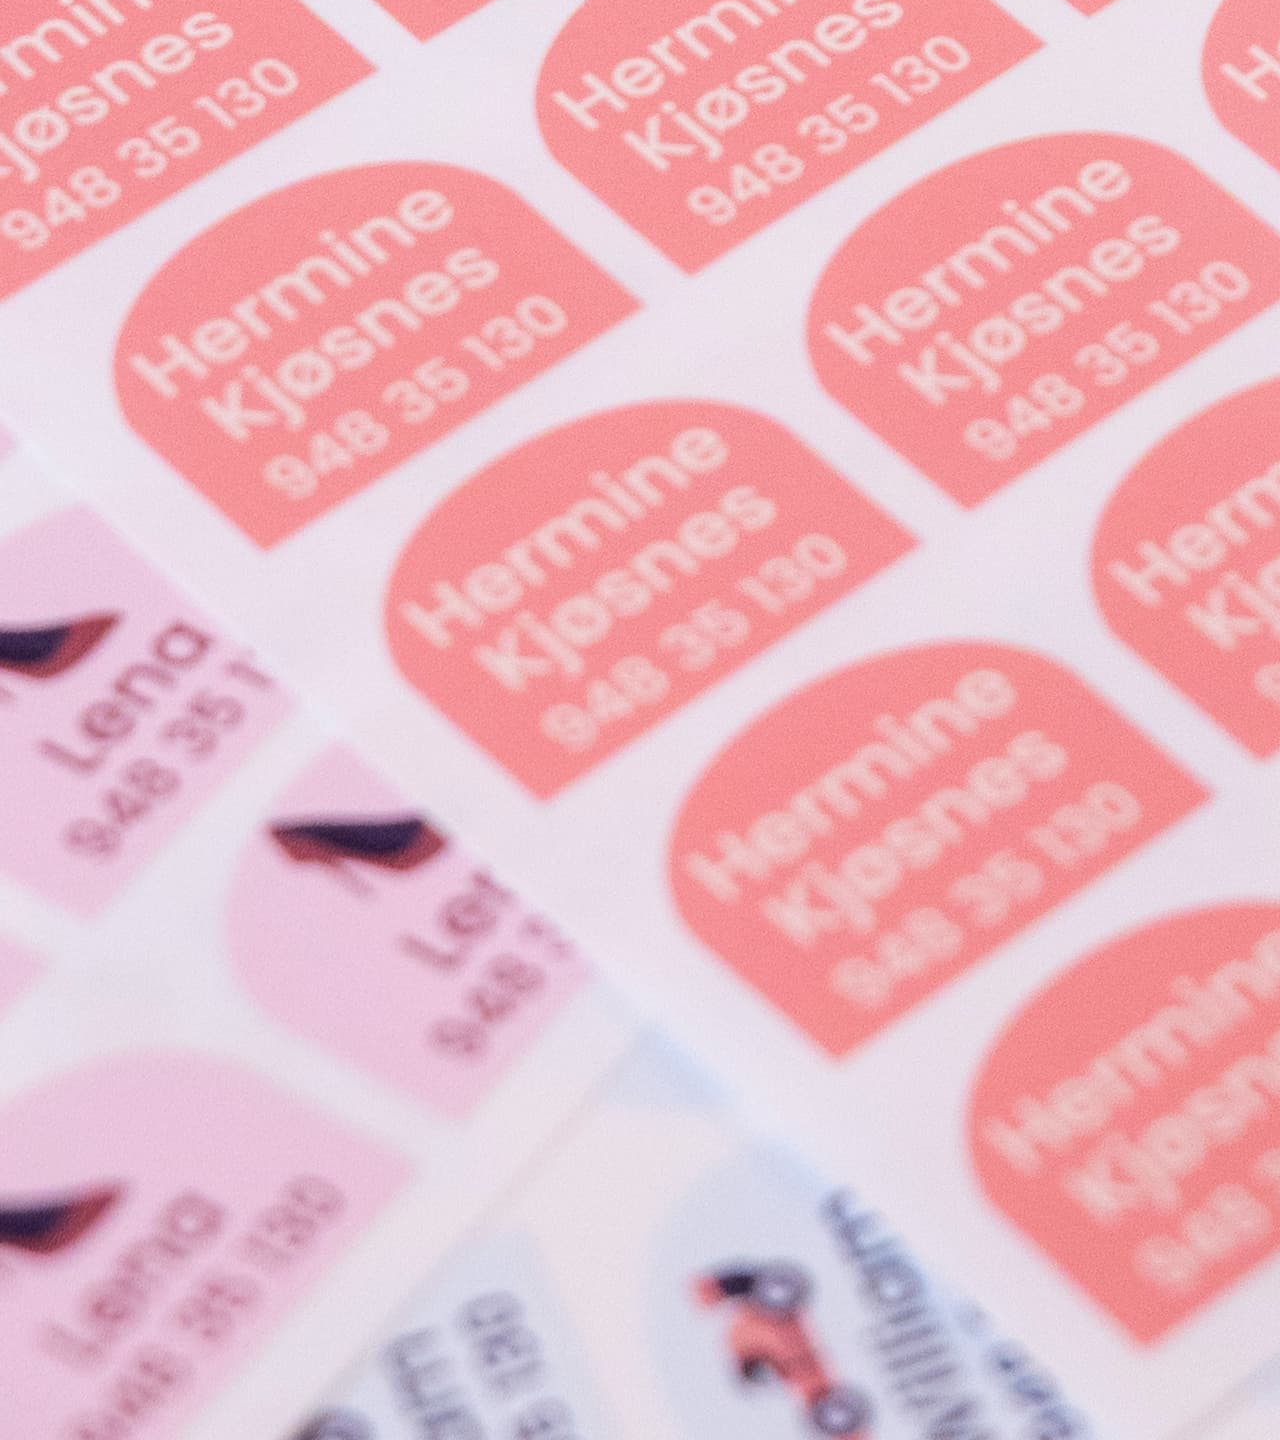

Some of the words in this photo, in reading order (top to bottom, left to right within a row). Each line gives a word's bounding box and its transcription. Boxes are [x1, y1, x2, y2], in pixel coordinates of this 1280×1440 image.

[0, 163, 122, 247] 948
[116, 113, 201, 176] 35
[191, 56, 298, 128] 130
[687, 142, 803, 224] 948
[798, 93, 878, 153] 35
[869, 35, 970, 105] 130
[41, 621, 213, 774] Lena
